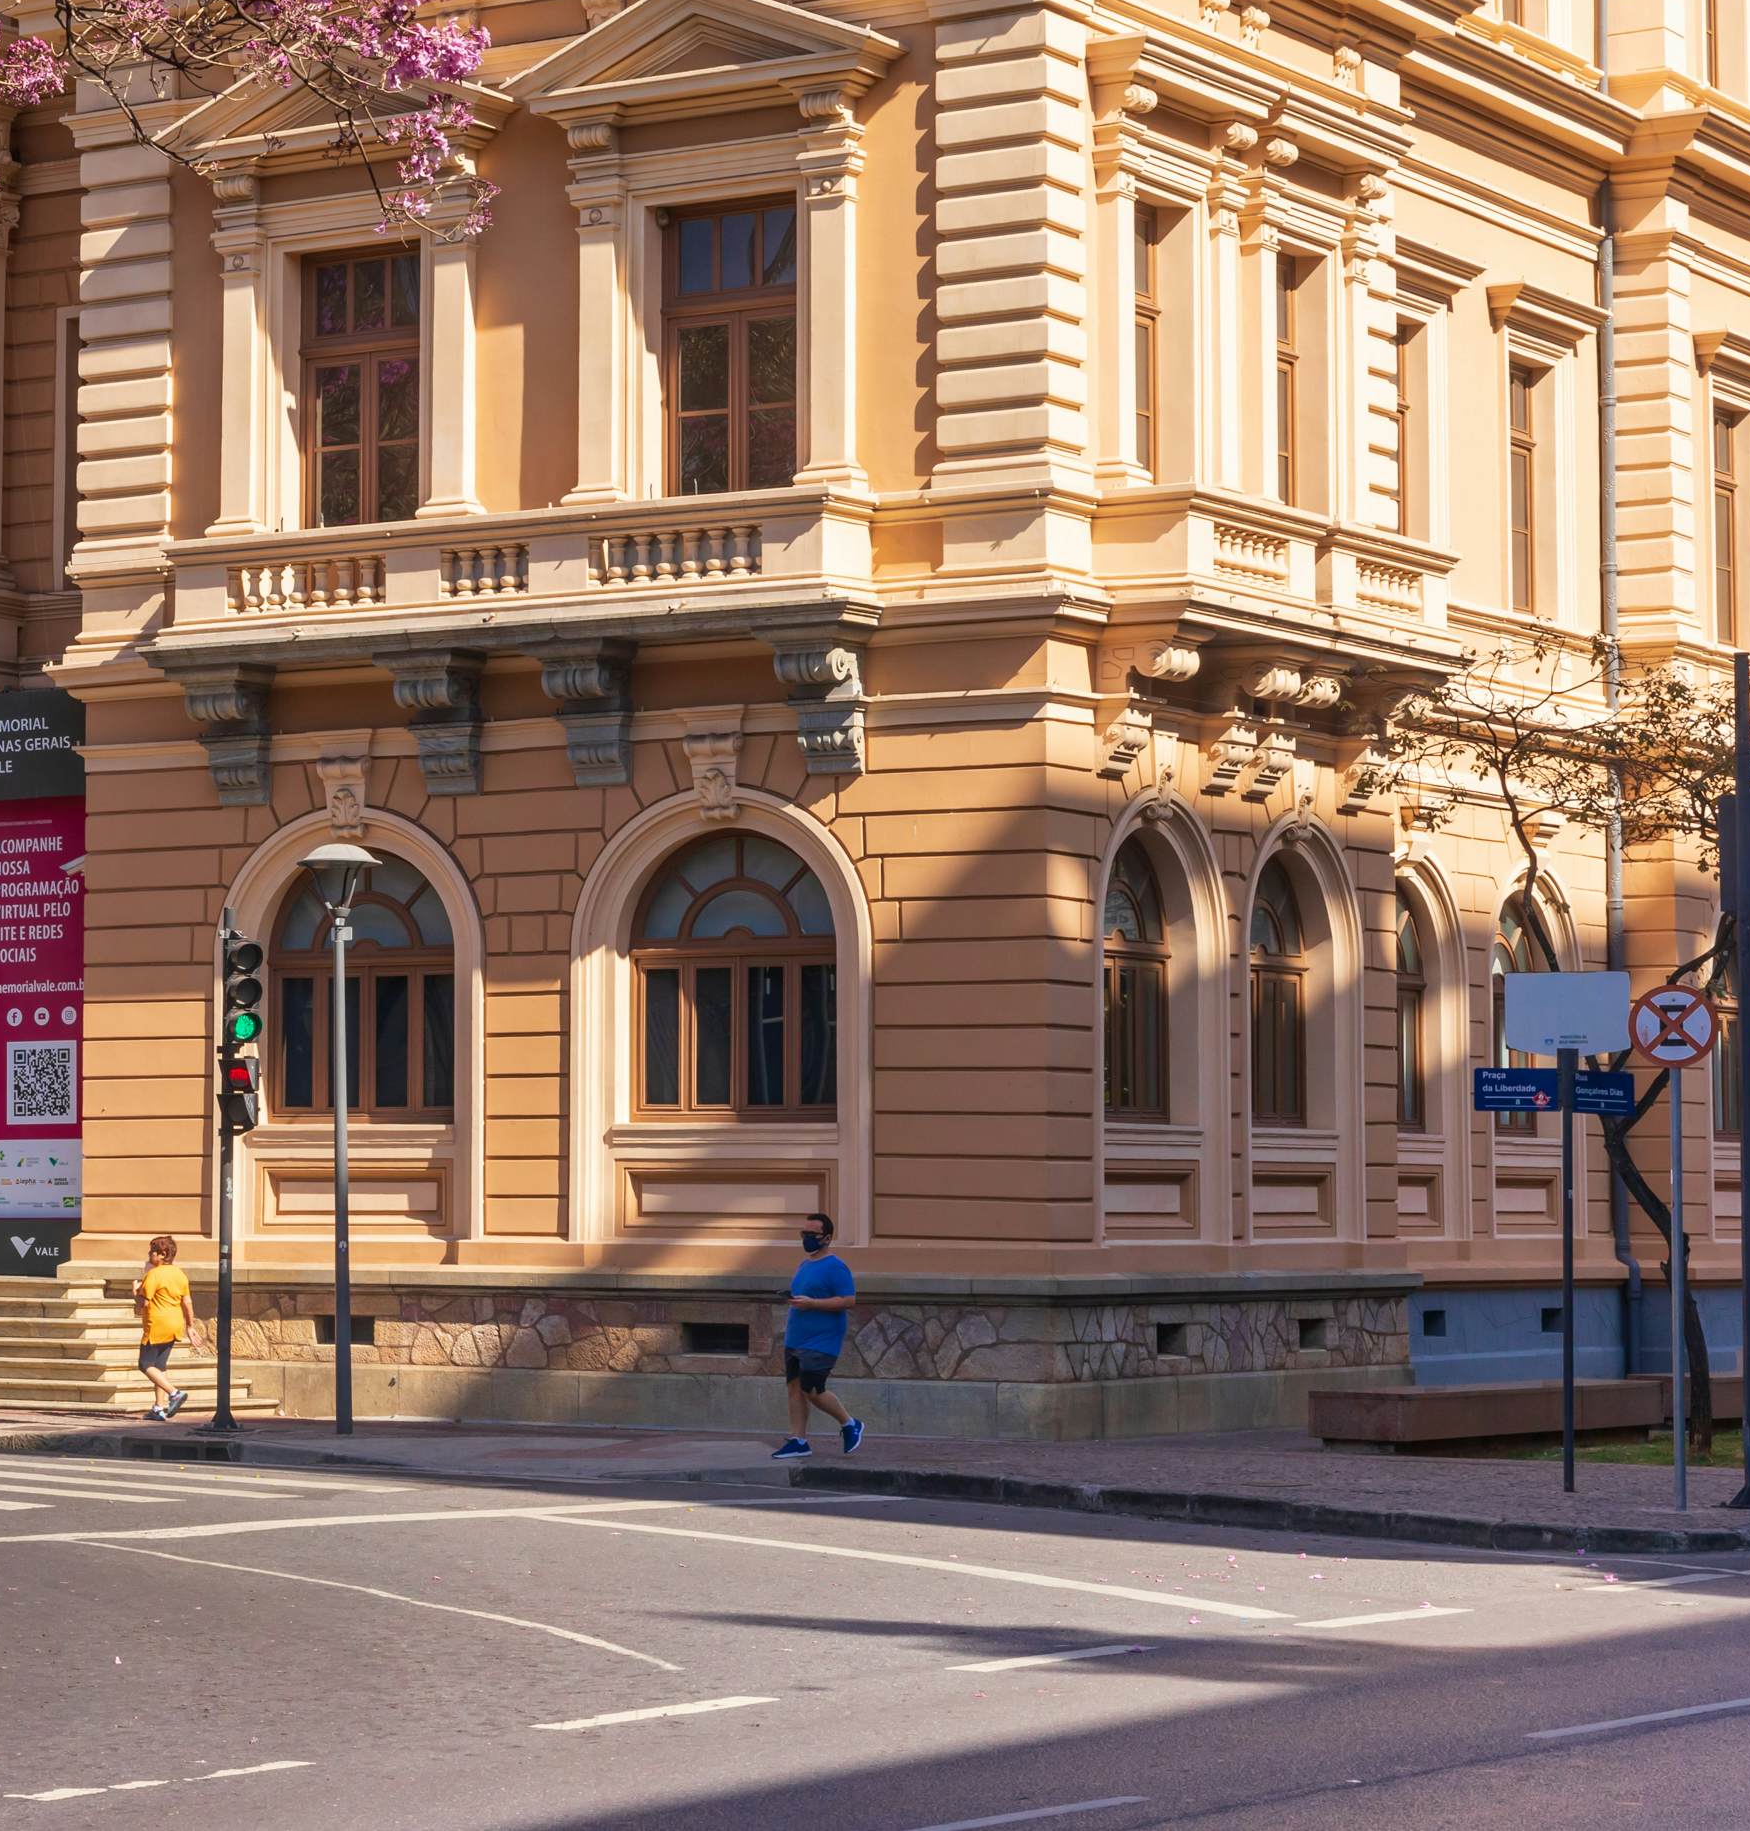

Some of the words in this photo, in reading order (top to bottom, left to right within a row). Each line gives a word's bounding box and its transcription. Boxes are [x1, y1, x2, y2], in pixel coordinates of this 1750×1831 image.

[24, 736, 71, 751] GERAIS
[43, 902, 71, 917] PELO
[19, 925, 26, 940] E
[28, 924, 64, 940] REDES
[1482, 1071, 1506, 1080] Praça
[1482, 1084, 1493, 1092] da
[1494, 1084, 1537, 1093] Liberdade
[1609, 1087, 1624, 1097] Dias
[34, 1247, 60, 1257] VALE
